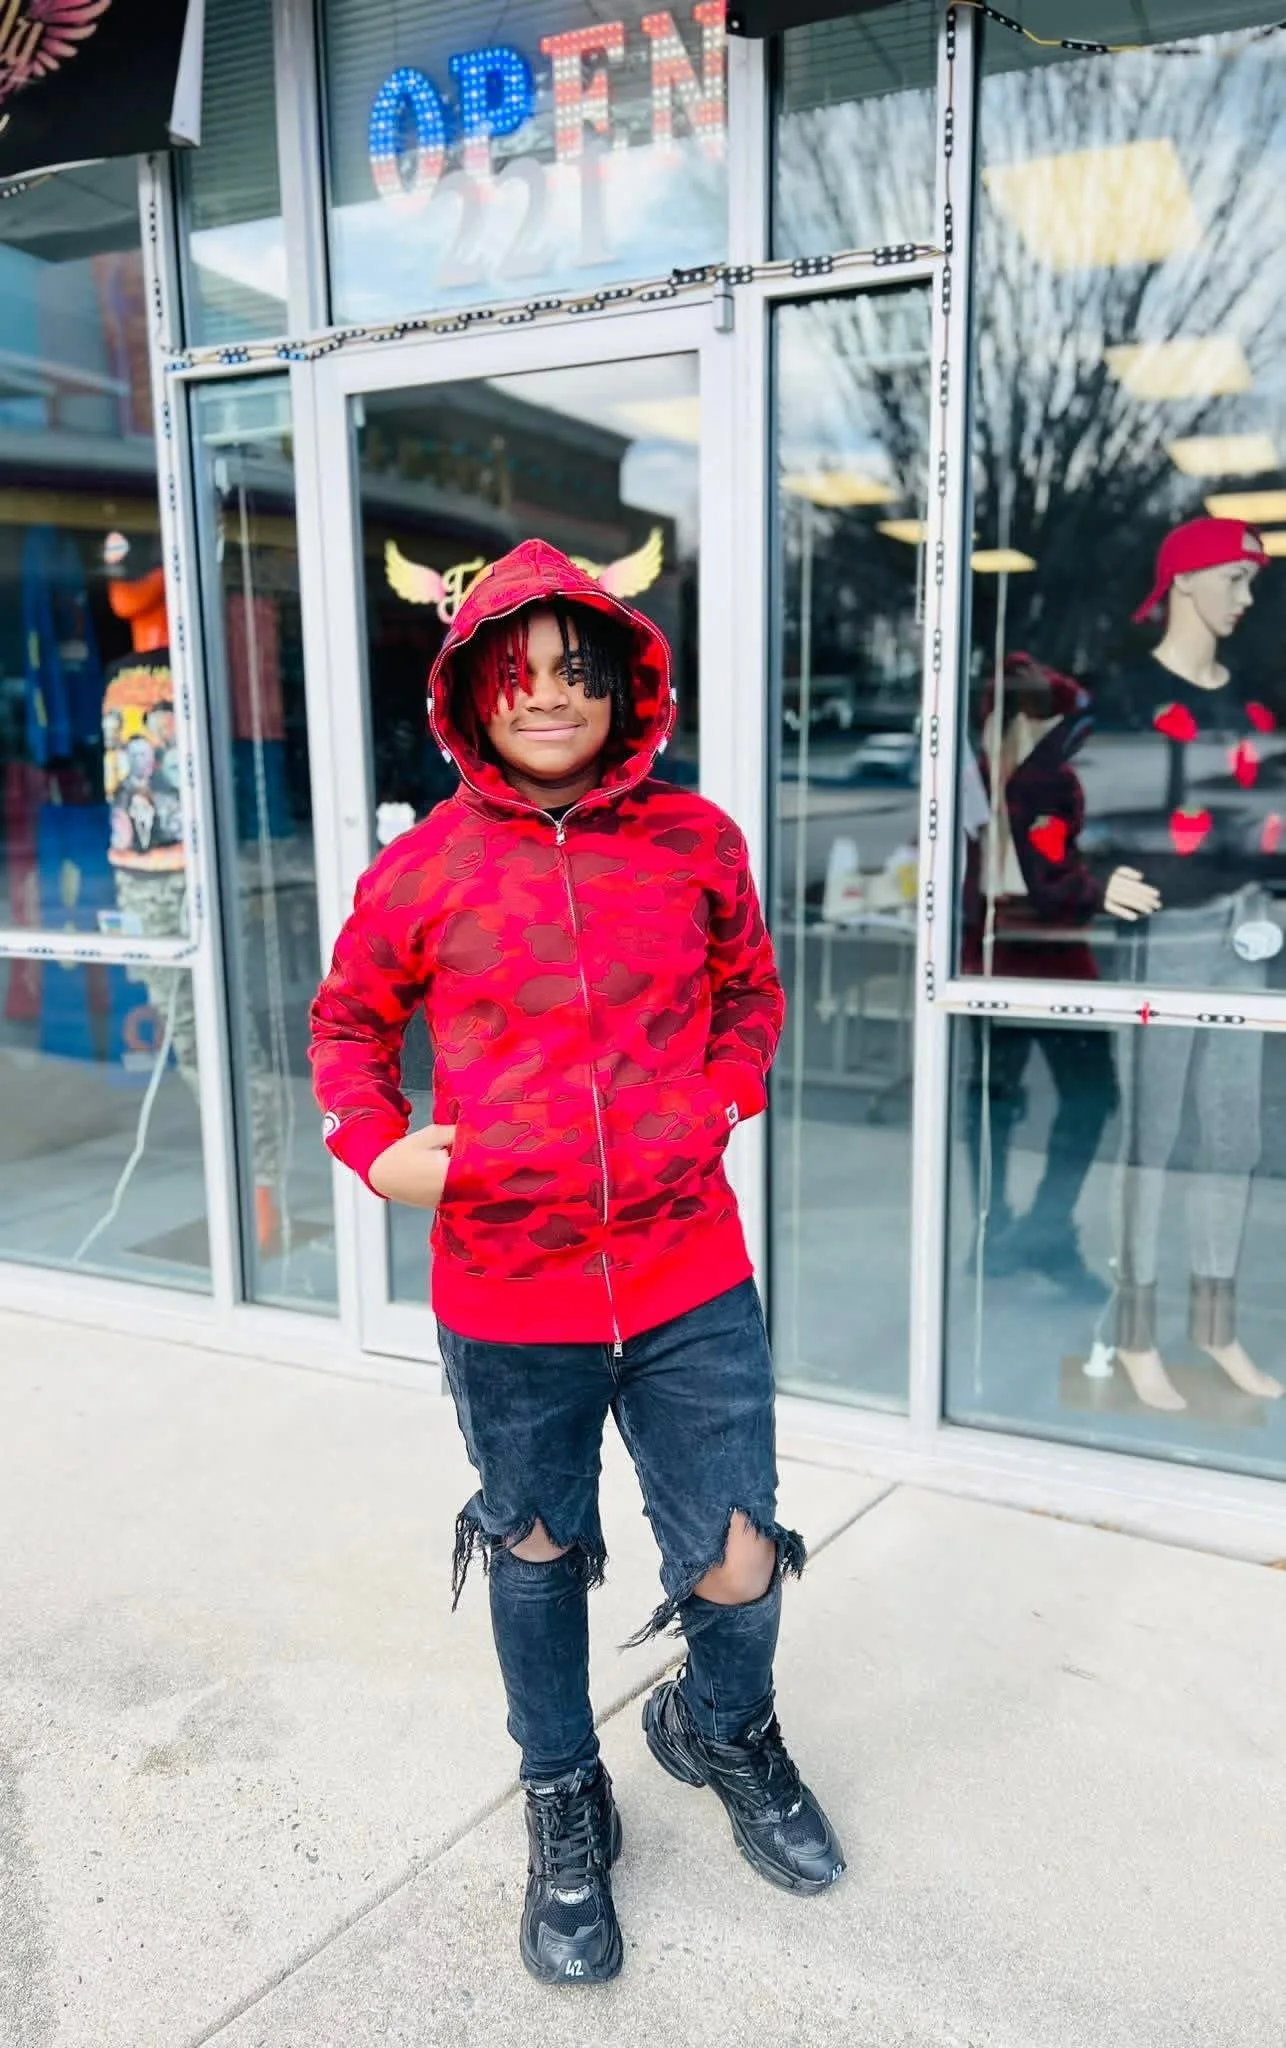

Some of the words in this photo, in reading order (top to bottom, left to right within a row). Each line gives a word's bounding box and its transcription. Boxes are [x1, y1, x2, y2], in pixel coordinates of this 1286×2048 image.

[368, 0, 727, 206] OPEN
[431, 134, 622, 288] 221
[565, 1959, 584, 1976] 42
